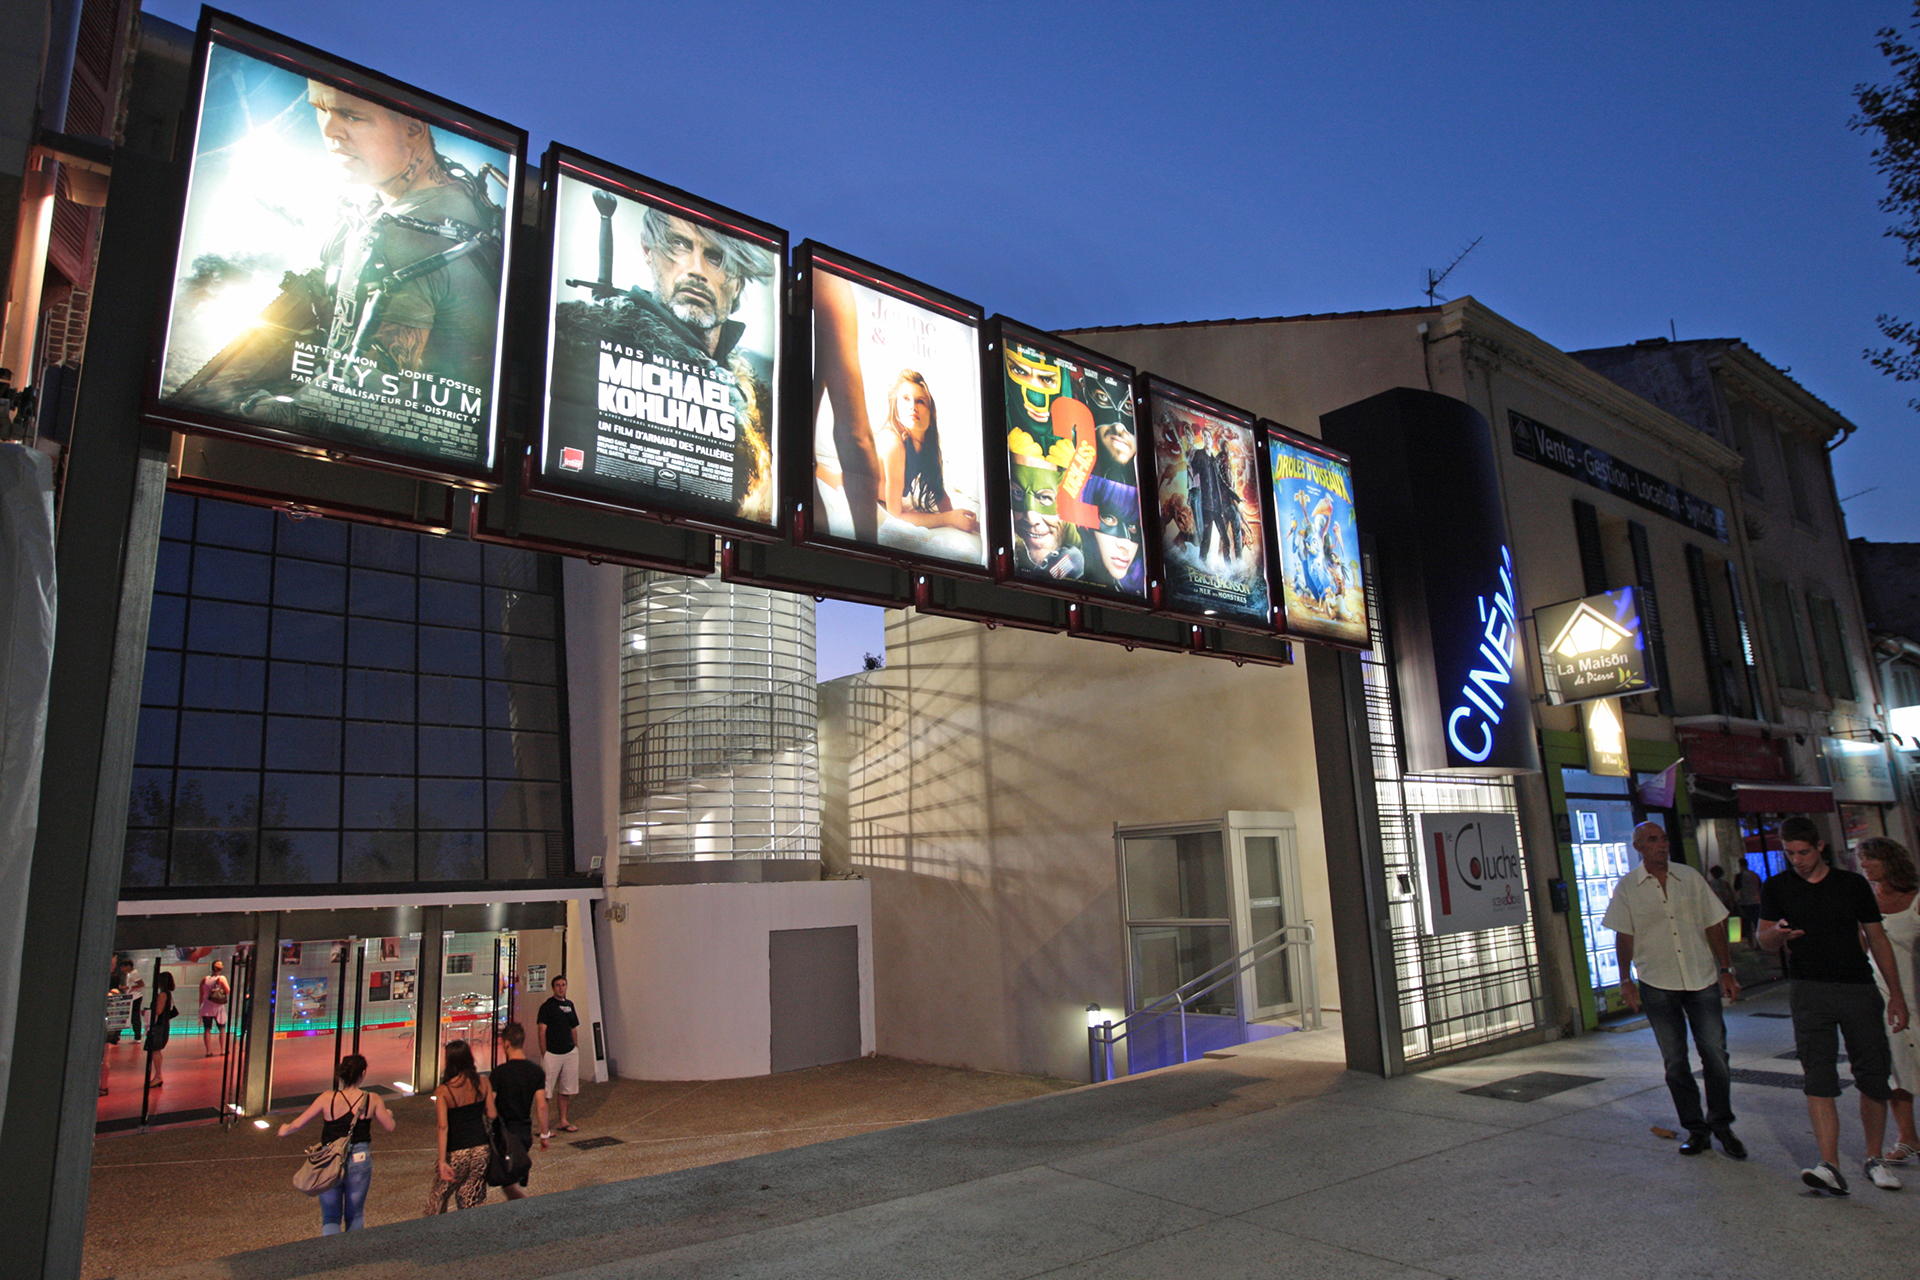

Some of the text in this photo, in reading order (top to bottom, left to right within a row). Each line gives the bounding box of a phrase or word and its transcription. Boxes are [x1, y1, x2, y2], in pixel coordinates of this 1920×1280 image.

[295, 341, 378, 369] MATT DAMON
[600, 339, 736, 385] MADS MIKKELSEN
[290, 373, 312, 385] PAR
[315, 379, 328, 389] LE
[331, 381, 401, 406] RÉALISATEUR
[404, 399, 418, 410] DE
[292, 350, 482, 417] ELYSIUM
[398, 368, 482, 396] JODIE FOSTER
[598, 351, 736, 413] MICHAEL
[597, 382, 736, 442] KOHLHAAS
[598, 420, 612, 432] UN
[613, 424, 633, 437] FILM
[635, 429, 677, 449] D'ARNAUD
[678, 440, 695, 453] DES
[695, 445, 734, 462] PALLIÈRES
[1050, 396, 1101, 530] 2
[1062, 440, 1097, 499] KICK-ASS
[1306, 459, 1352, 505] D'OISEAUX
[1534, 426, 1576, 469] Vente
[1584, 449, 1630, 492] Gestion
[1635, 472, 1680, 514] Location
[1186, 565, 1251, 594] PERCY JACKSON
[1199, 588, 1211, 596] MER
[1218, 592, 1247, 604] MONSTRES
[1557, 663, 1575, 676] La
[1574, 674, 1585, 686] de
[1445, 823, 1518, 891] le Coluche
